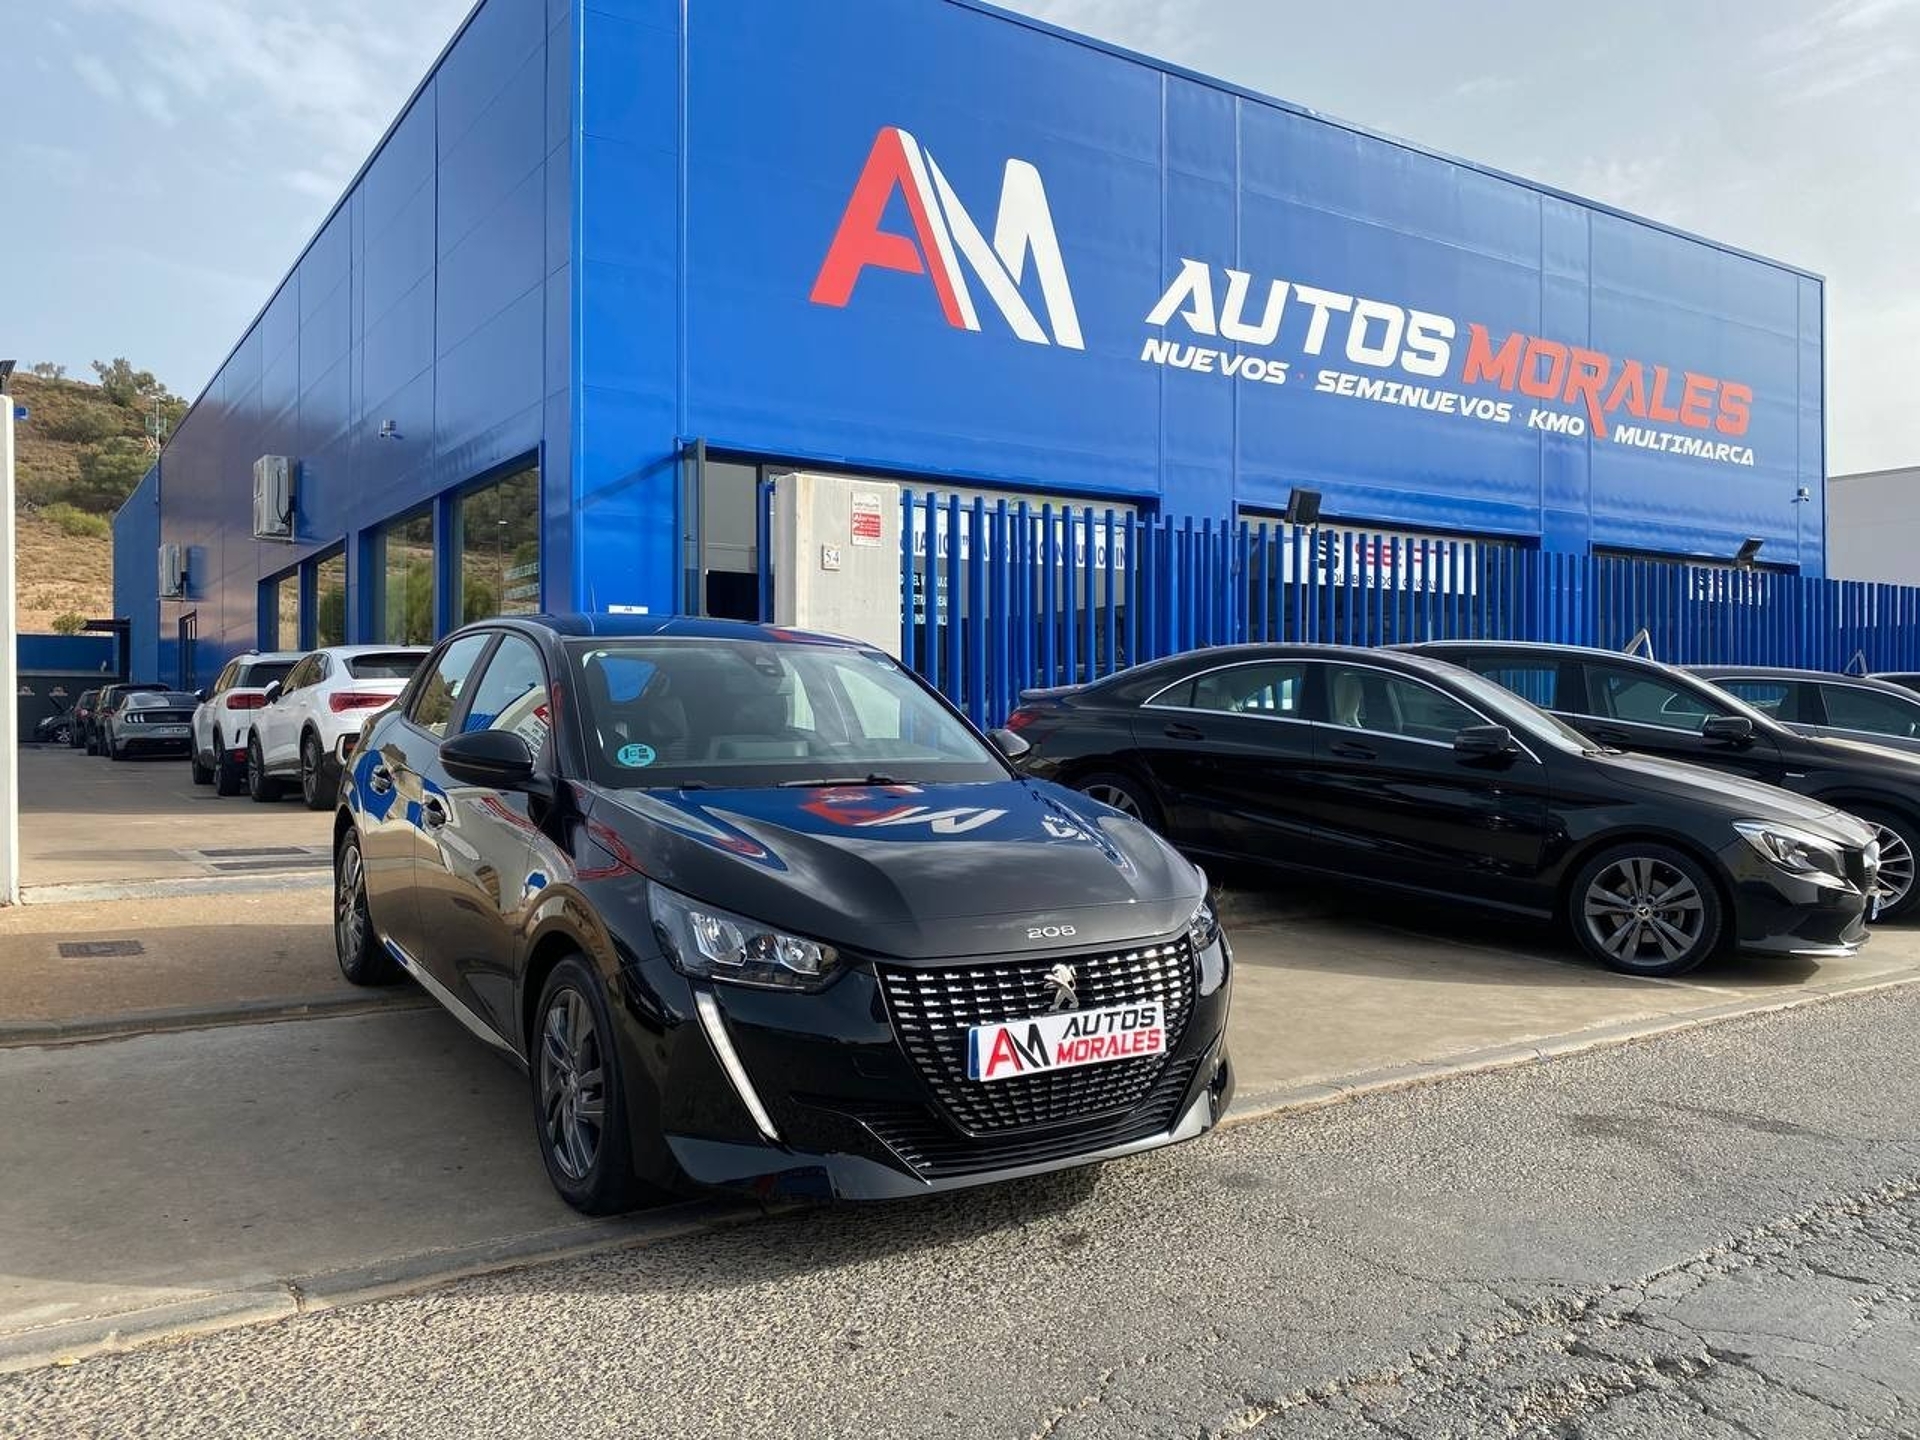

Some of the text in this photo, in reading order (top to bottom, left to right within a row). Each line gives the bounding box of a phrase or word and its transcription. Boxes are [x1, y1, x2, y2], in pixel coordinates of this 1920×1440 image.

[809, 125, 1086, 350] AM
[1144, 257, 1753, 438] AUTOS MORALES
[1141, 338, 1290, 384] NUEVOS
[1315, 369, 1513, 423] SEMINUEVOS
[1613, 425, 1754, 465] MULTIMARCA
[825, 550, 839, 564] 54
[1027, 925, 1077, 939] 208
[1062, 1007, 1157, 1040] AUTOS
[985, 1023, 1051, 1077] AM
[1056, 1029, 1161, 1065] MORALES
